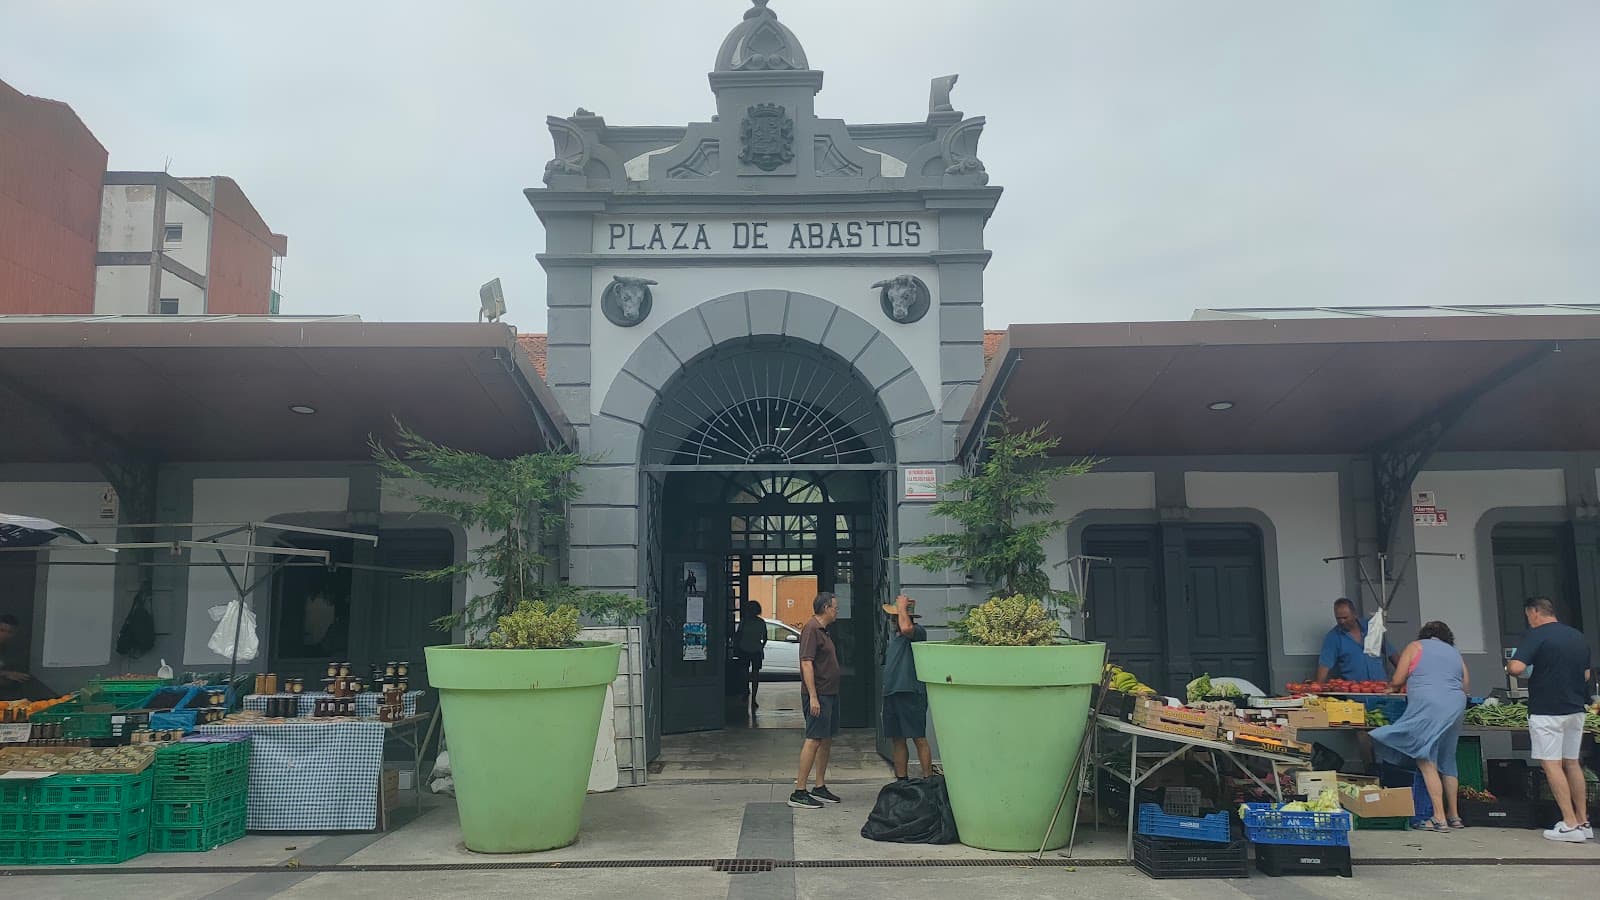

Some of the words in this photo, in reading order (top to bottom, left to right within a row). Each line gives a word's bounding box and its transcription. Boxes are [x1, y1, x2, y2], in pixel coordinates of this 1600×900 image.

[608, 223, 711, 250] PLAZA
[732, 221, 769, 249] DE
[788, 220, 921, 249] ABASTOS
